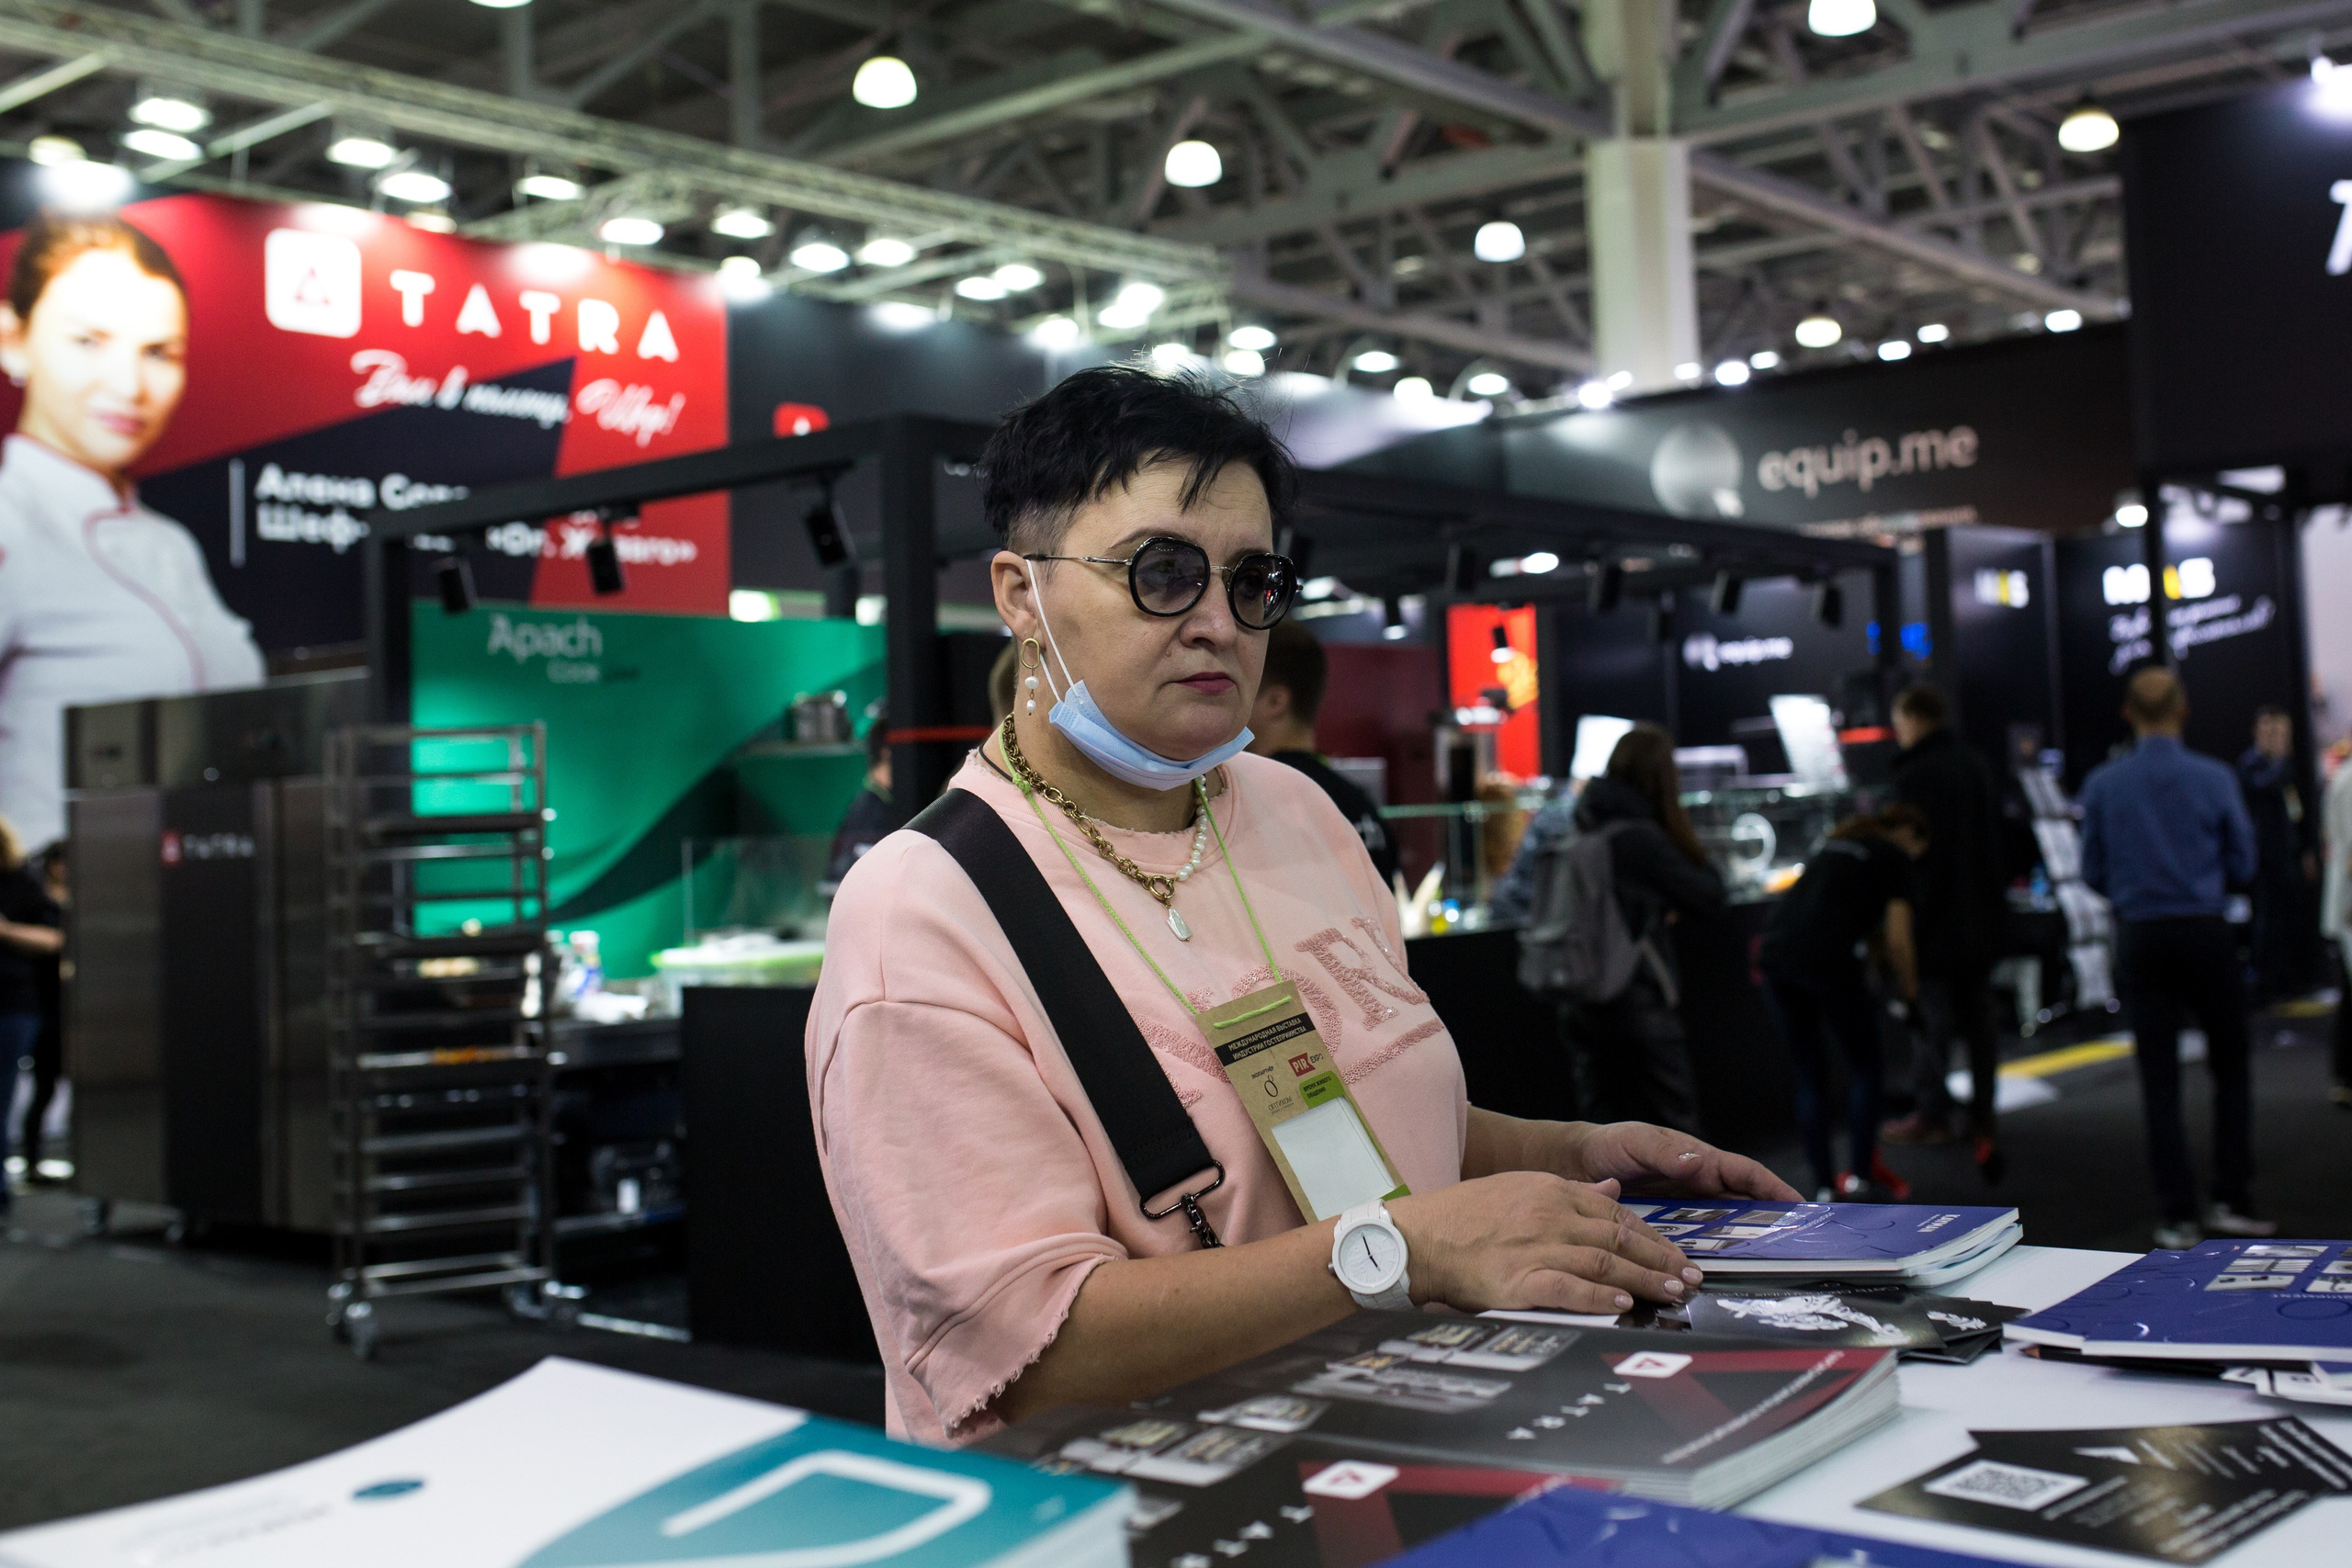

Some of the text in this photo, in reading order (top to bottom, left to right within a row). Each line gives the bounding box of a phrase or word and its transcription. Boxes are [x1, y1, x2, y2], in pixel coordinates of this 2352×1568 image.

[390, 269, 680, 363] TATRA
[254, 462, 377, 509] Алена
[1758, 425, 1979, 499] equip.me
[488, 613, 603, 664] Apach
[1228, 1017, 1302, 1051] МЕЖДУНАРОДНАЯ ВЫСТАВКА
[1232, 1025, 1306, 1060] ИНДУСТРИИ ГОСТЕПРИИМСТВА
[1292, 1058, 1309, 1073] PIR
[1506, 1382, 1633, 1440] TATRA
